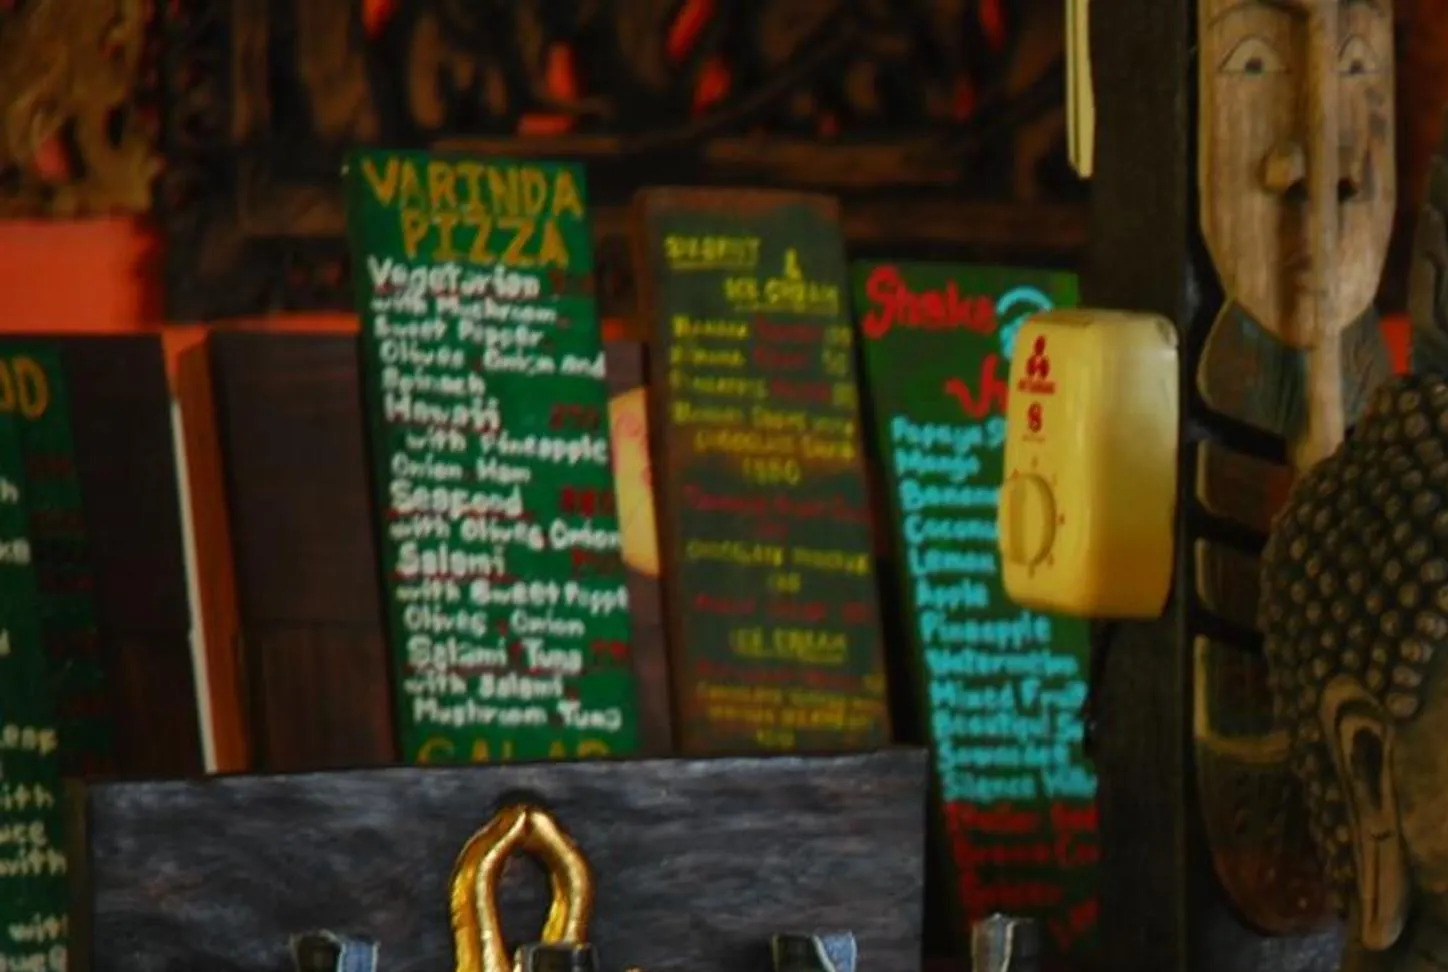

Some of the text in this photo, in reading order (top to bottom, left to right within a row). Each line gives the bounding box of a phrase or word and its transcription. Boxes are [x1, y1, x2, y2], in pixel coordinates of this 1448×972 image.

[361, 156, 584, 220] VARINDA
[401, 206, 569, 268] PIZZA
[405, 427, 609, 465] with Pineapple
[389, 517, 450, 542] with
[395, 579, 461, 603] with
[915, 577, 990, 611] Apple
[920, 608, 1052, 652] Pineapple
[404, 669, 467, 696] with
[412, 697, 623, 735] Mushroom Tuna
